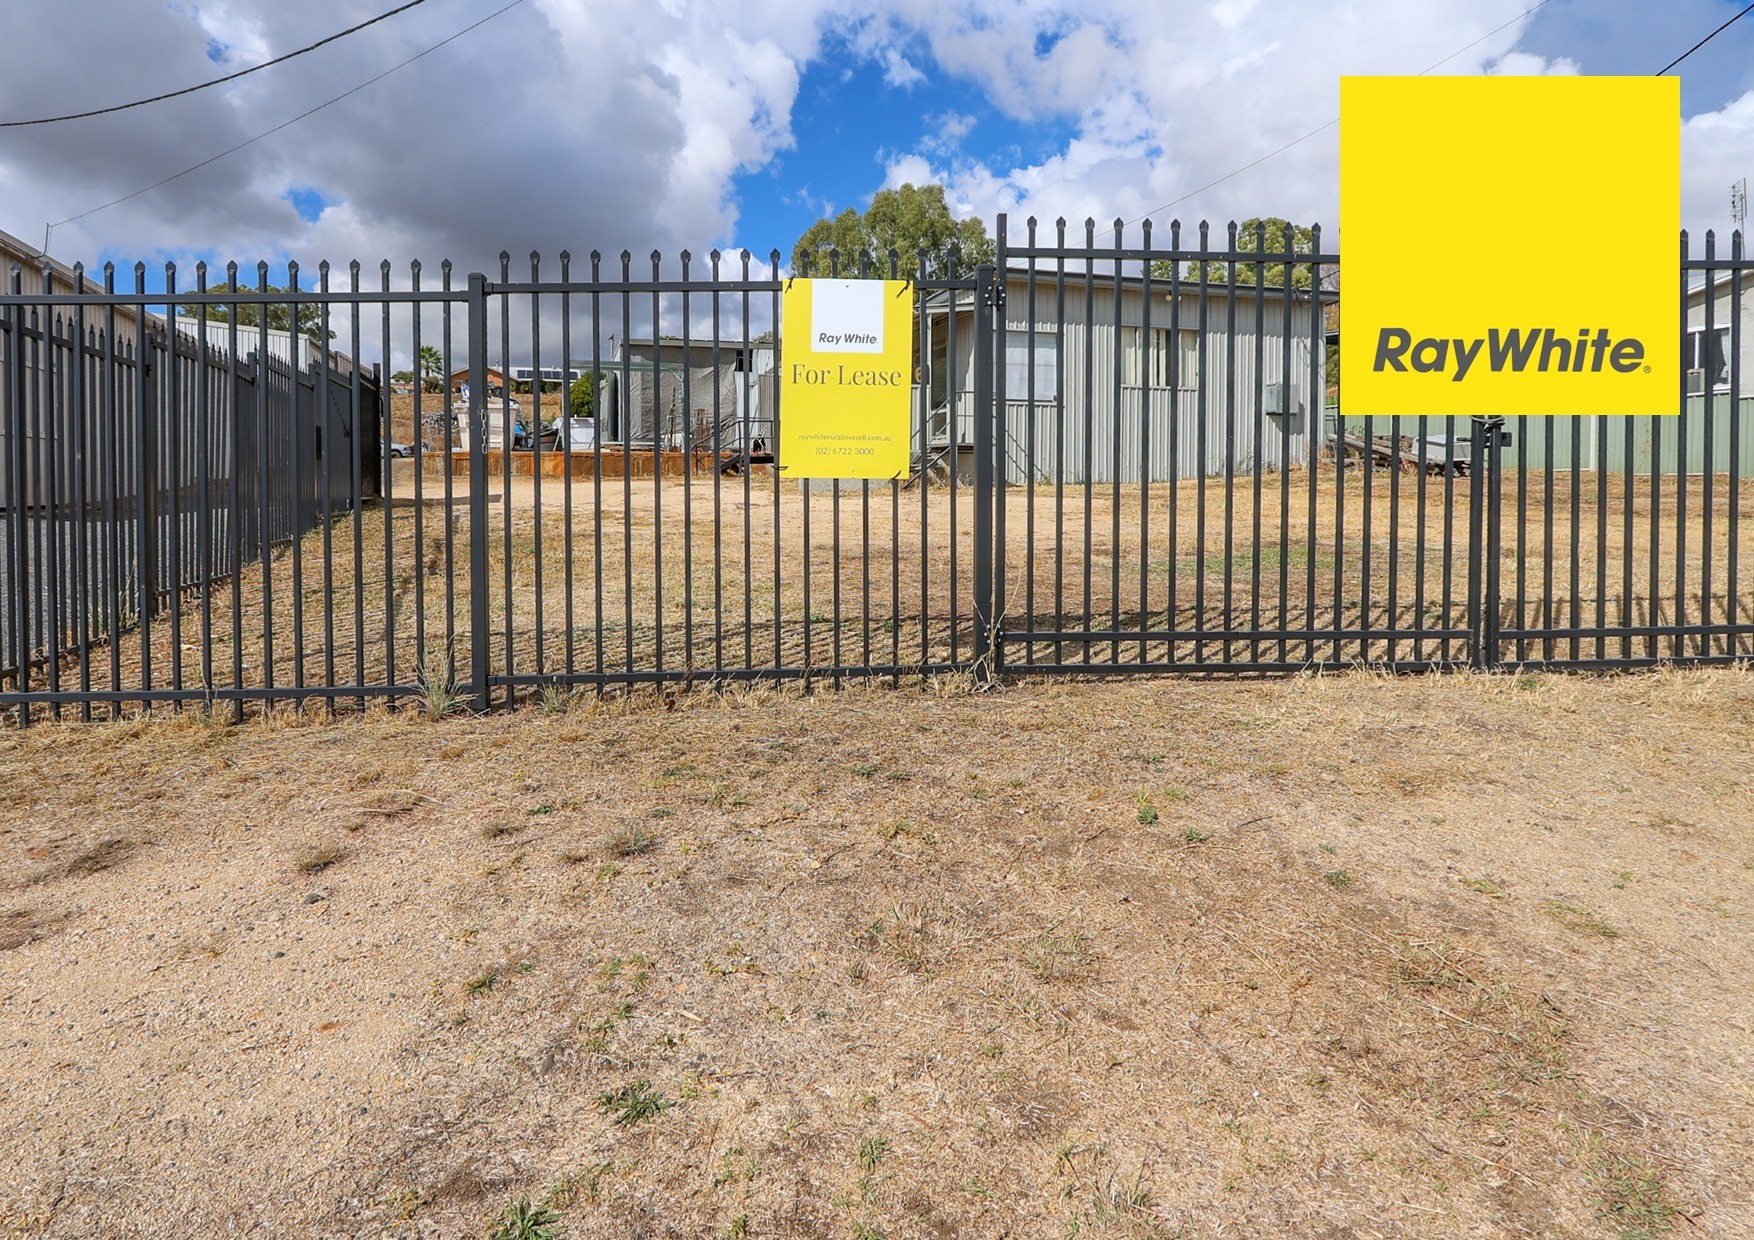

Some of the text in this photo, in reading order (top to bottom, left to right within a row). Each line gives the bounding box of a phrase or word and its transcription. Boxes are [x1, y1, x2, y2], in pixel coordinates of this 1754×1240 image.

[818, 332, 877, 345] Ray White
[792, 364, 902, 386] For Lease
[799, 433, 891, 442] raywhiteruralinverell.com.au
[815, 447, 831, 455] (02)
[832, 447, 853, 455] 6722
